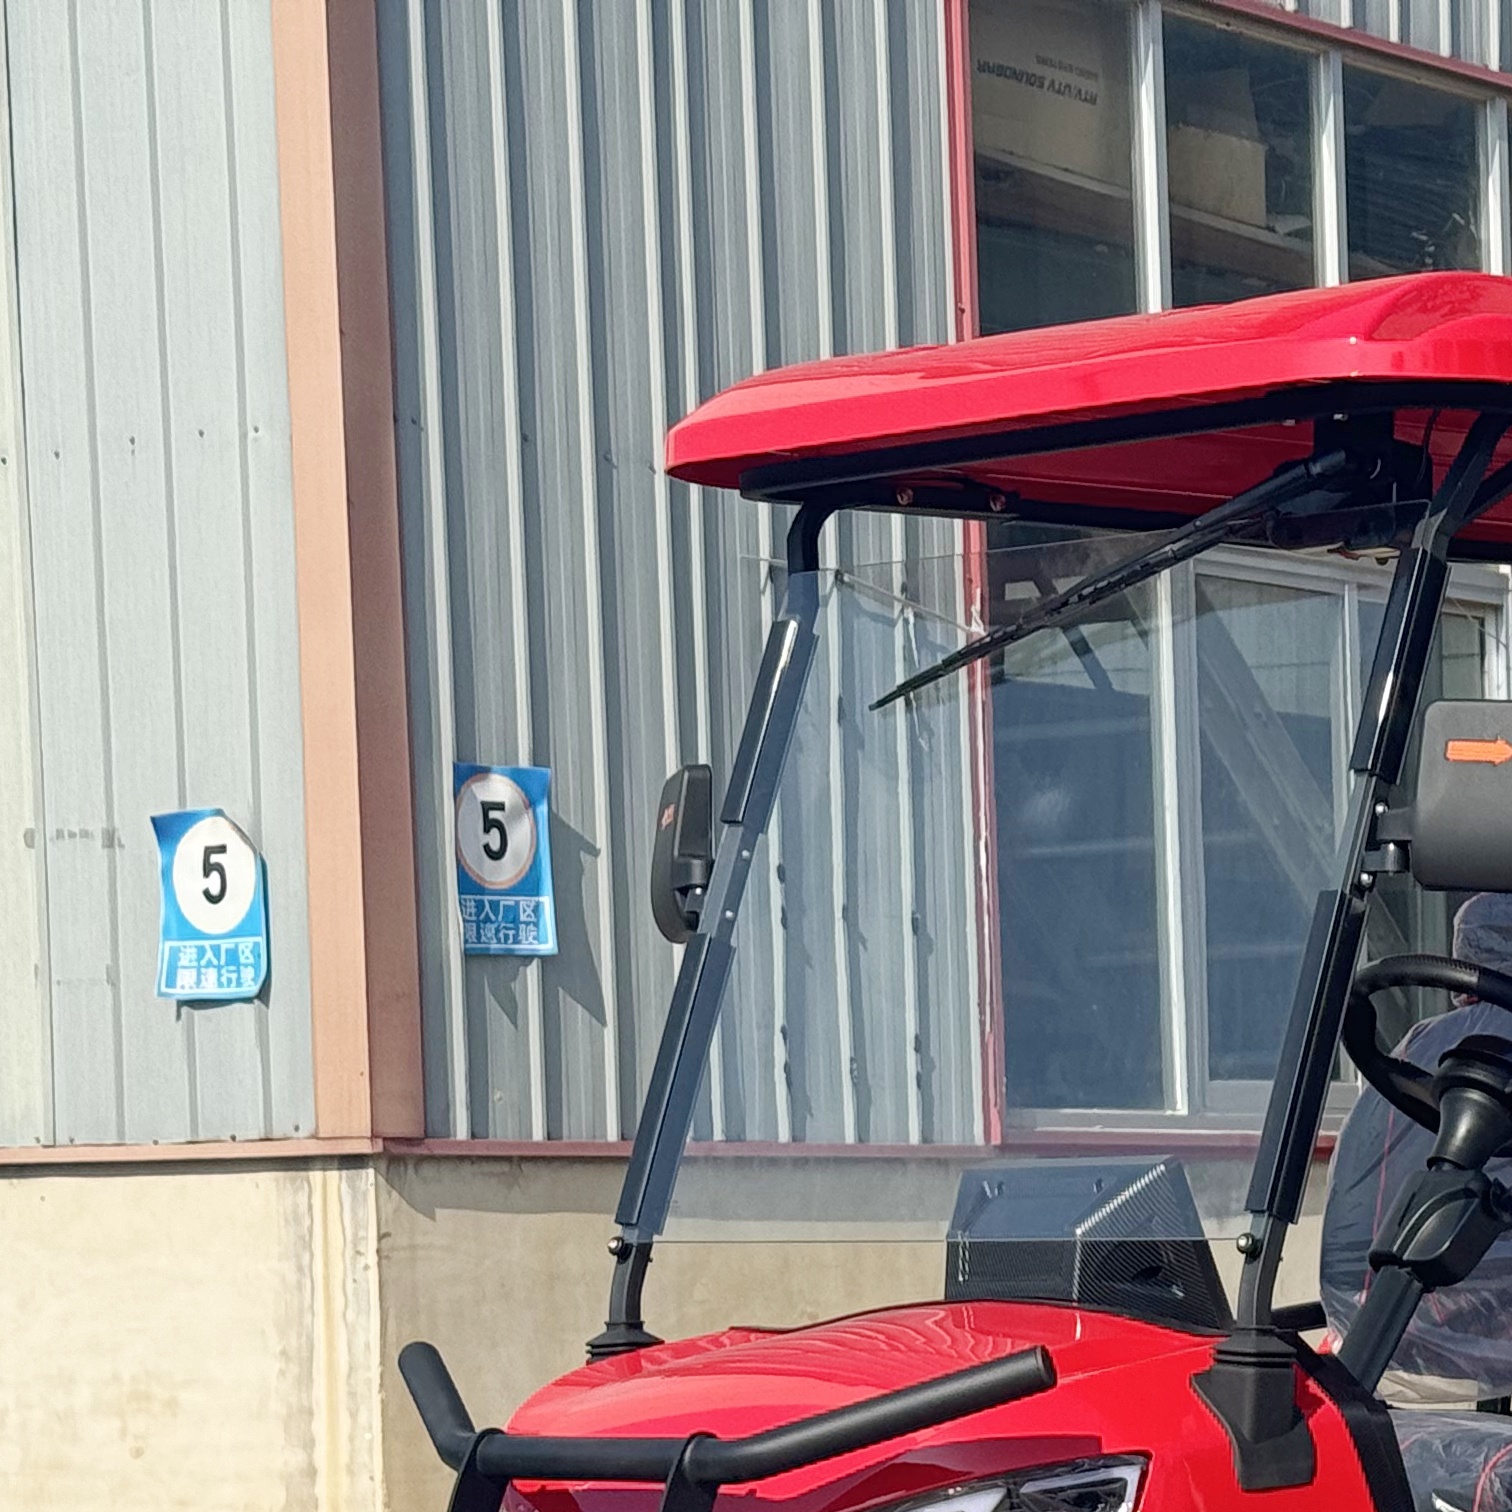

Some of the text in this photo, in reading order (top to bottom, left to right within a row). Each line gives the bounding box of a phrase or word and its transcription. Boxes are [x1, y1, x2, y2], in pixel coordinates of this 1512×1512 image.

[976, 59, 1046, 89] SOUNDBAR
[481, 801, 508, 860] 5
[202, 844, 228, 904] 5
[462, 897, 537, 922] 进入厂区
[177, 942, 255, 967] 进入厂区
